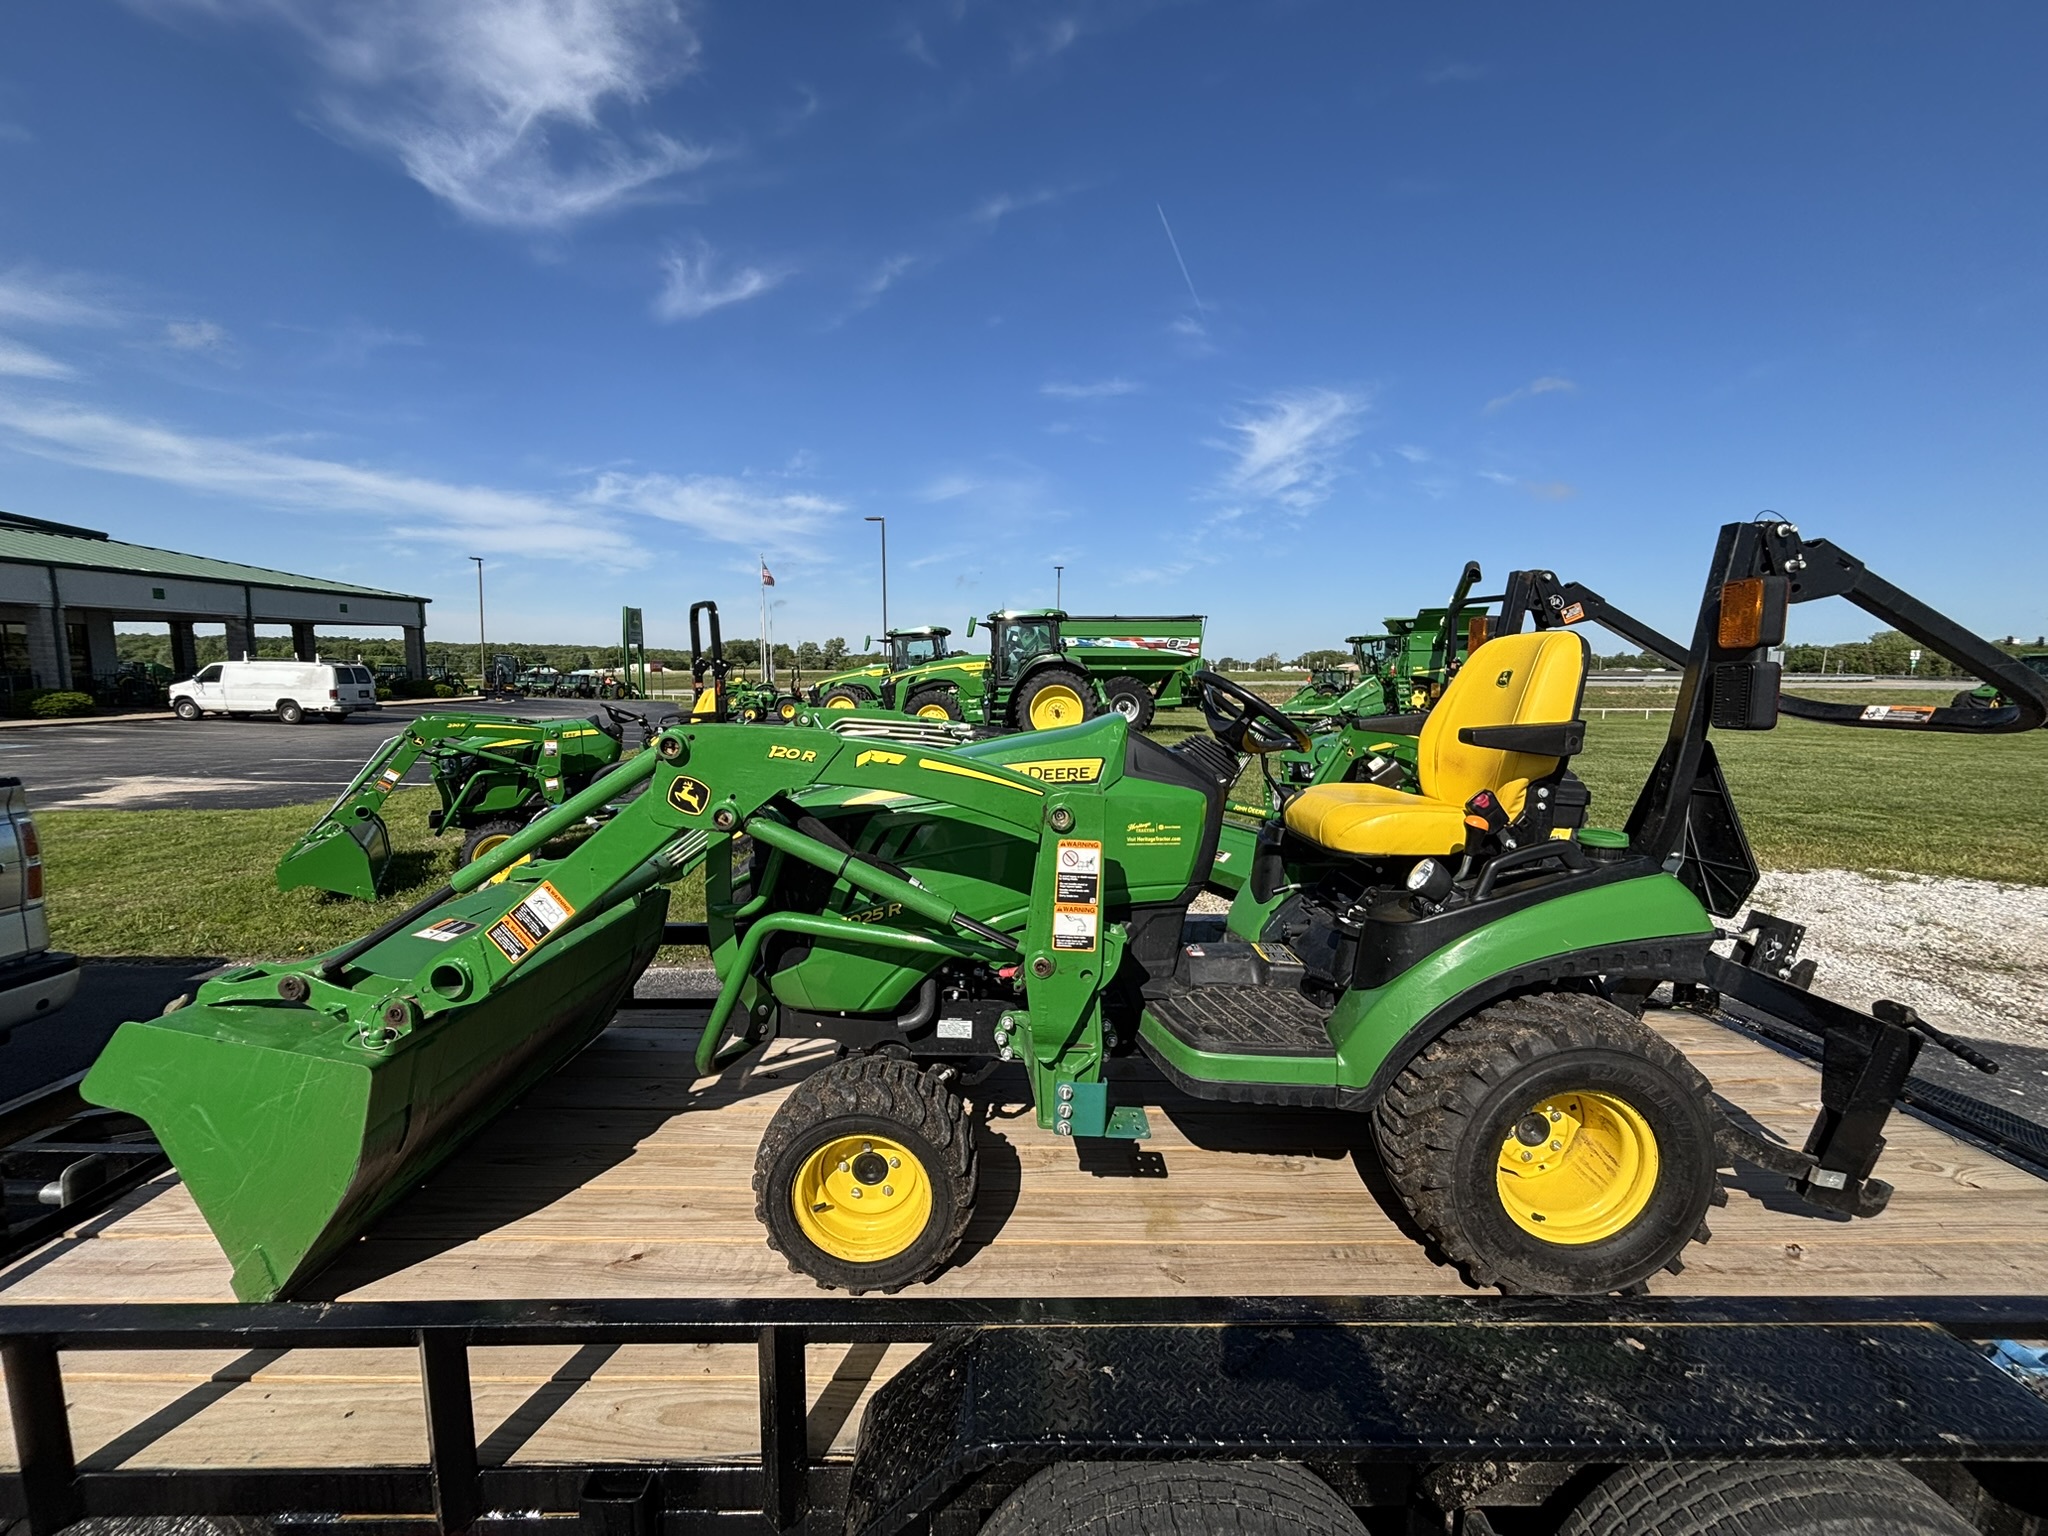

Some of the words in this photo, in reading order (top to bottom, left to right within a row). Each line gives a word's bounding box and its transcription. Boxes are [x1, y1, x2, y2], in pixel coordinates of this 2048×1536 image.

[768, 745, 801, 760] 120
[801, 750, 817, 763] R
[1029, 766, 1091, 781] DEERE
[1233, 804, 1248, 813] JOHN
[1247, 806, 1267, 817] DEERE
[1066, 841, 1099, 849] WARNING
[549, 890, 571, 912] WARNING
[847, 906, 885, 924] 025
[888, 902, 903, 918] R
[1062, 906, 1096, 914] WARNING
[510, 925, 531, 947] WARNING
